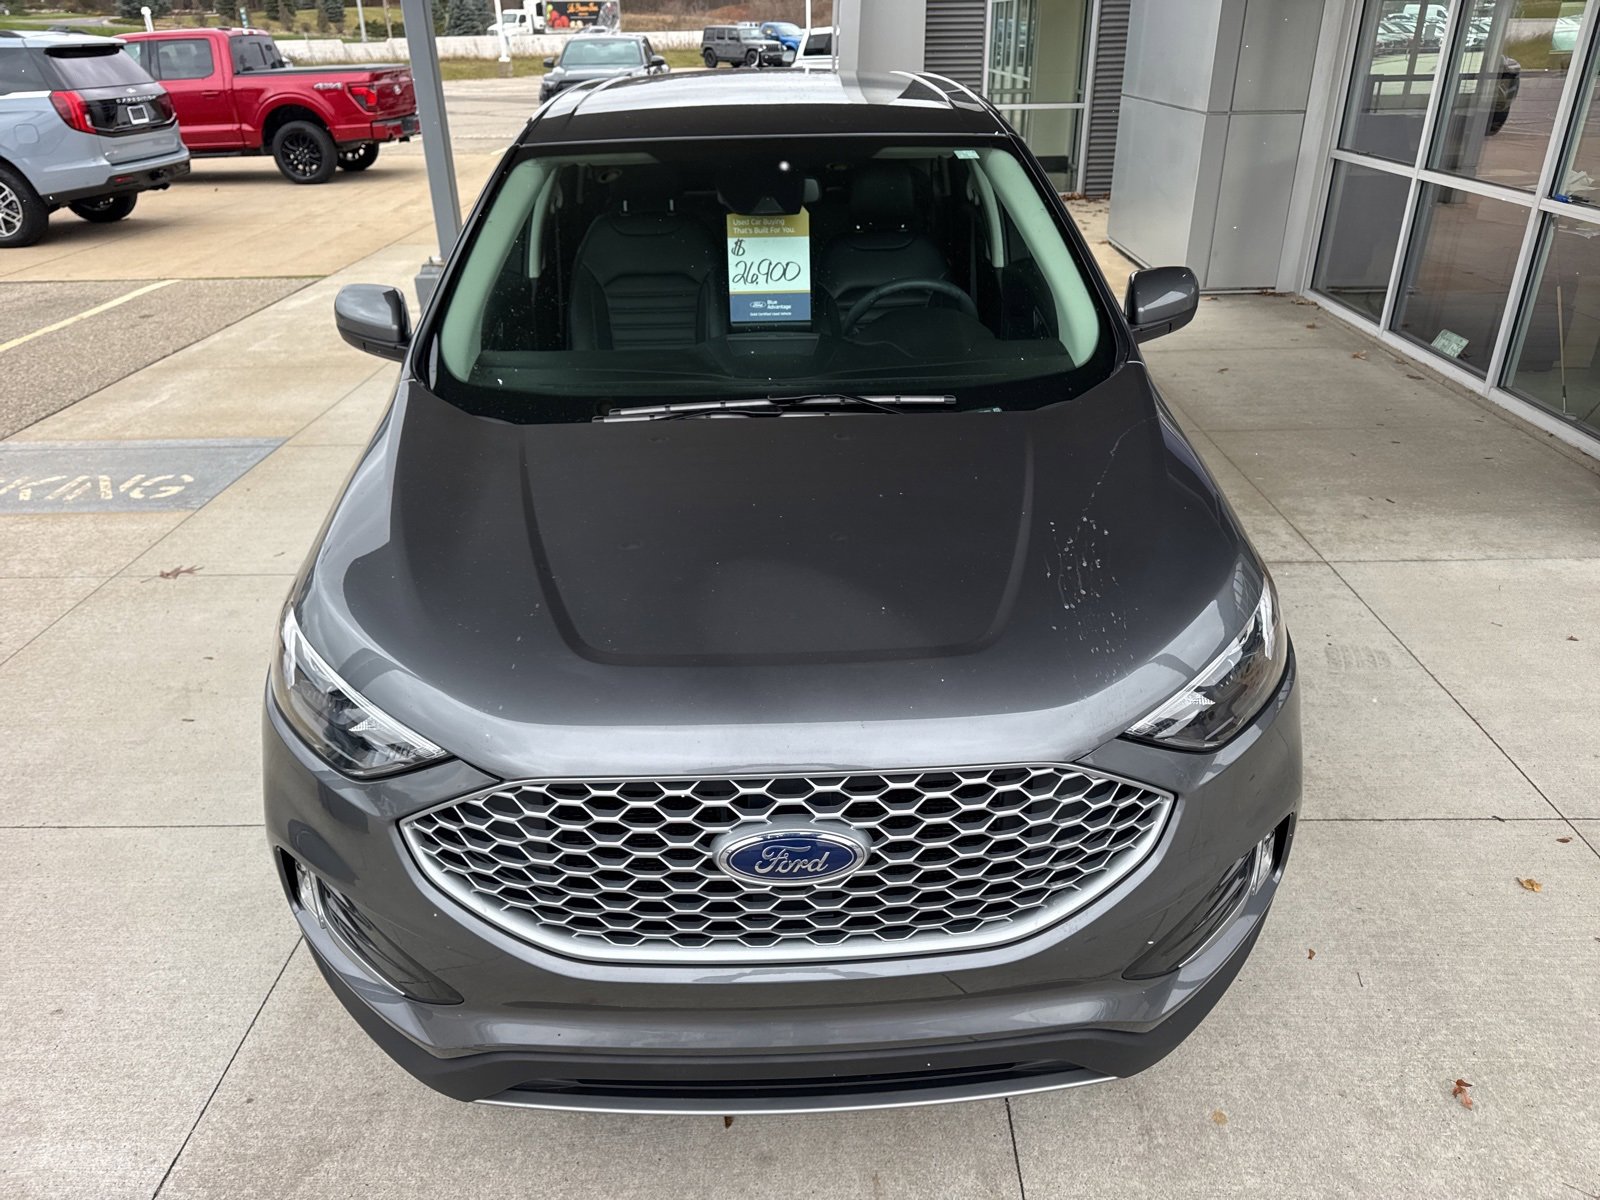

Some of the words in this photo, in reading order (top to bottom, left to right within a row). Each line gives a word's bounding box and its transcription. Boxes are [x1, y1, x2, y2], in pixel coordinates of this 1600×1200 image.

[763, 217, 785, 226] Buying
[733, 226, 753, 234] That's
[754, 226, 769, 234] Built
[731, 238, 746, 256] $
[754, 845, 830, 874] Ford
